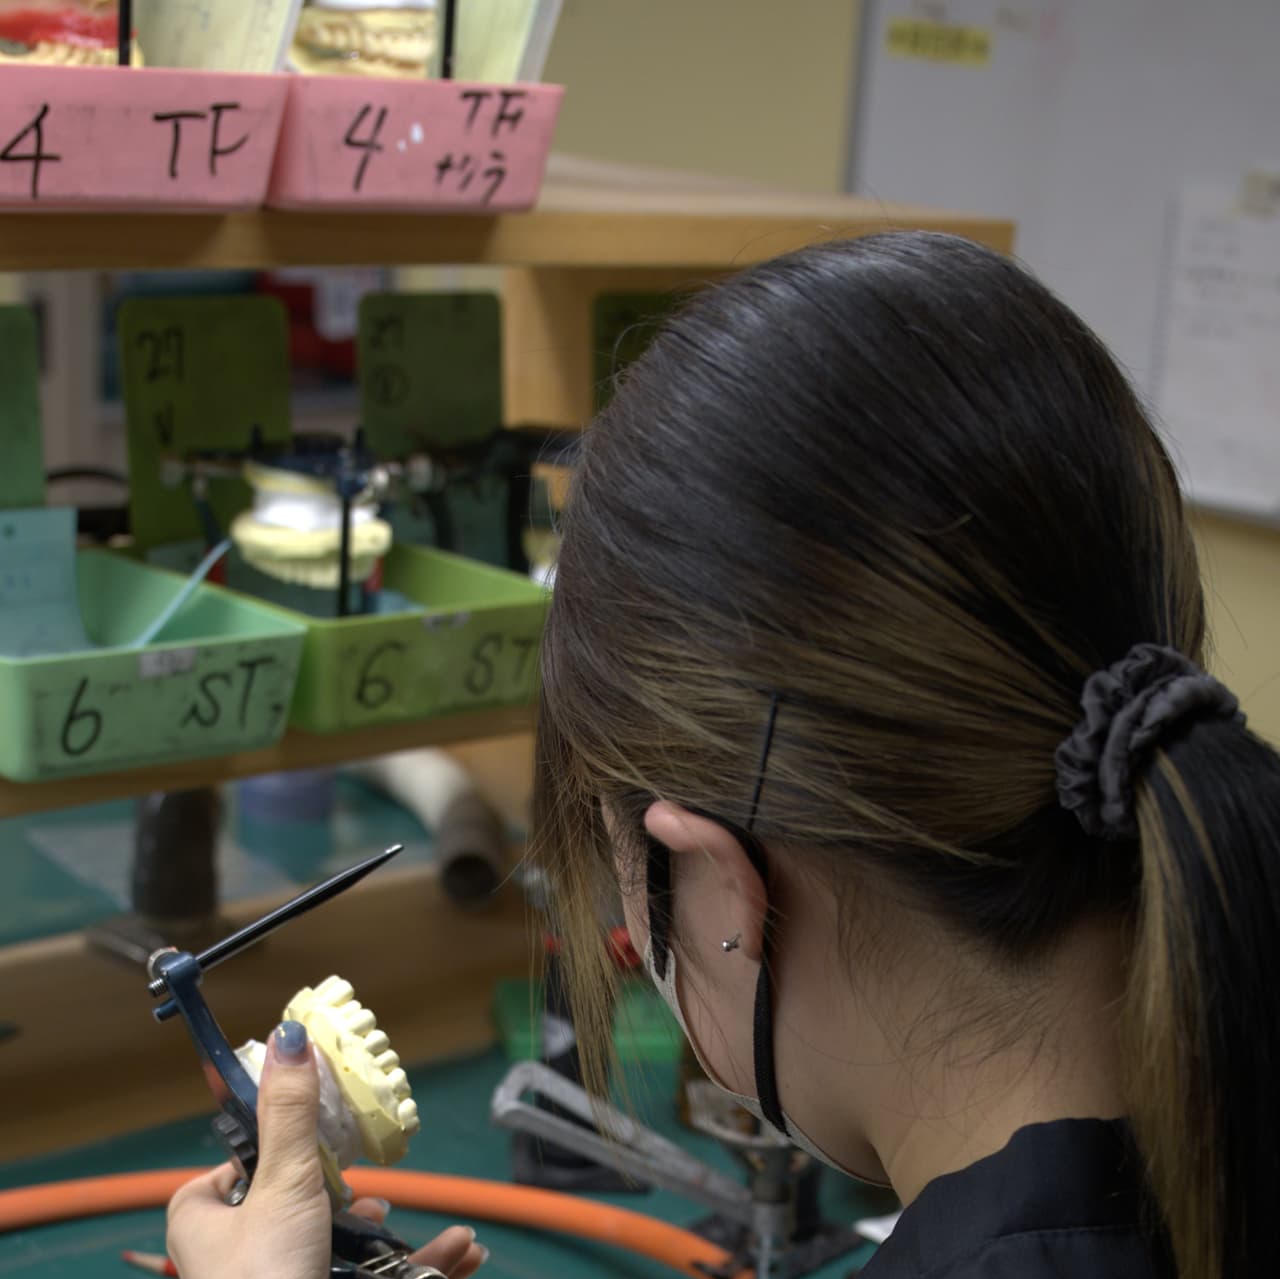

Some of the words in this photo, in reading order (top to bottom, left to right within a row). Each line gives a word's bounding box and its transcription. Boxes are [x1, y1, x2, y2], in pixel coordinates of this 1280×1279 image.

[152, 102, 249, 179] TF
[342, 104, 386, 191] 4
[354, 639, 407, 710] 6
[61, 677, 103, 757] 6
